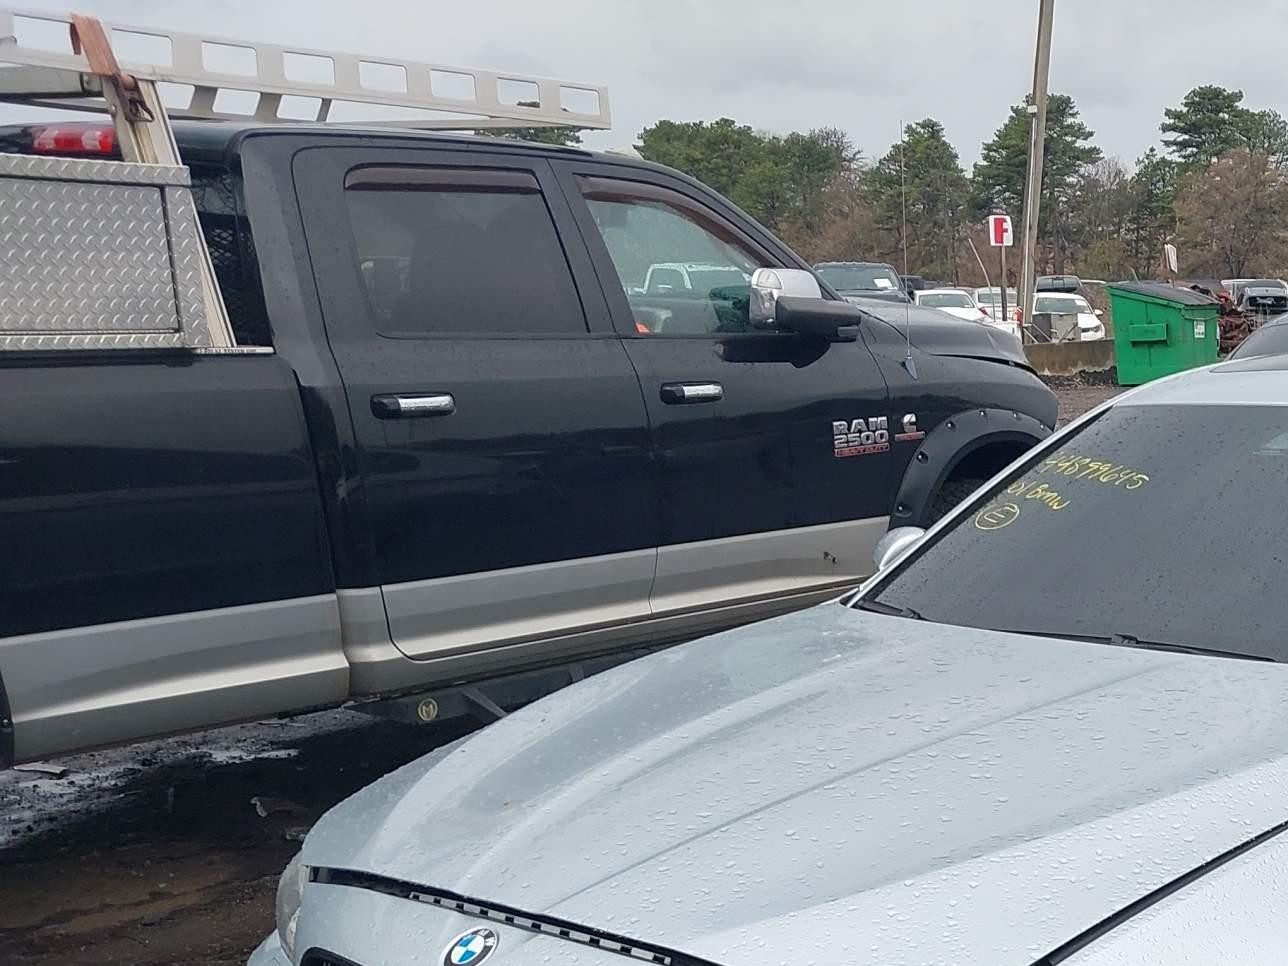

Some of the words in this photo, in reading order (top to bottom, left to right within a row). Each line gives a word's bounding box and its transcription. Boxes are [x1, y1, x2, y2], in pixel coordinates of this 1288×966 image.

[994, 218, 1008, 244] F
[832, 416, 888, 434] RAM
[834, 430, 889, 448] 2500
